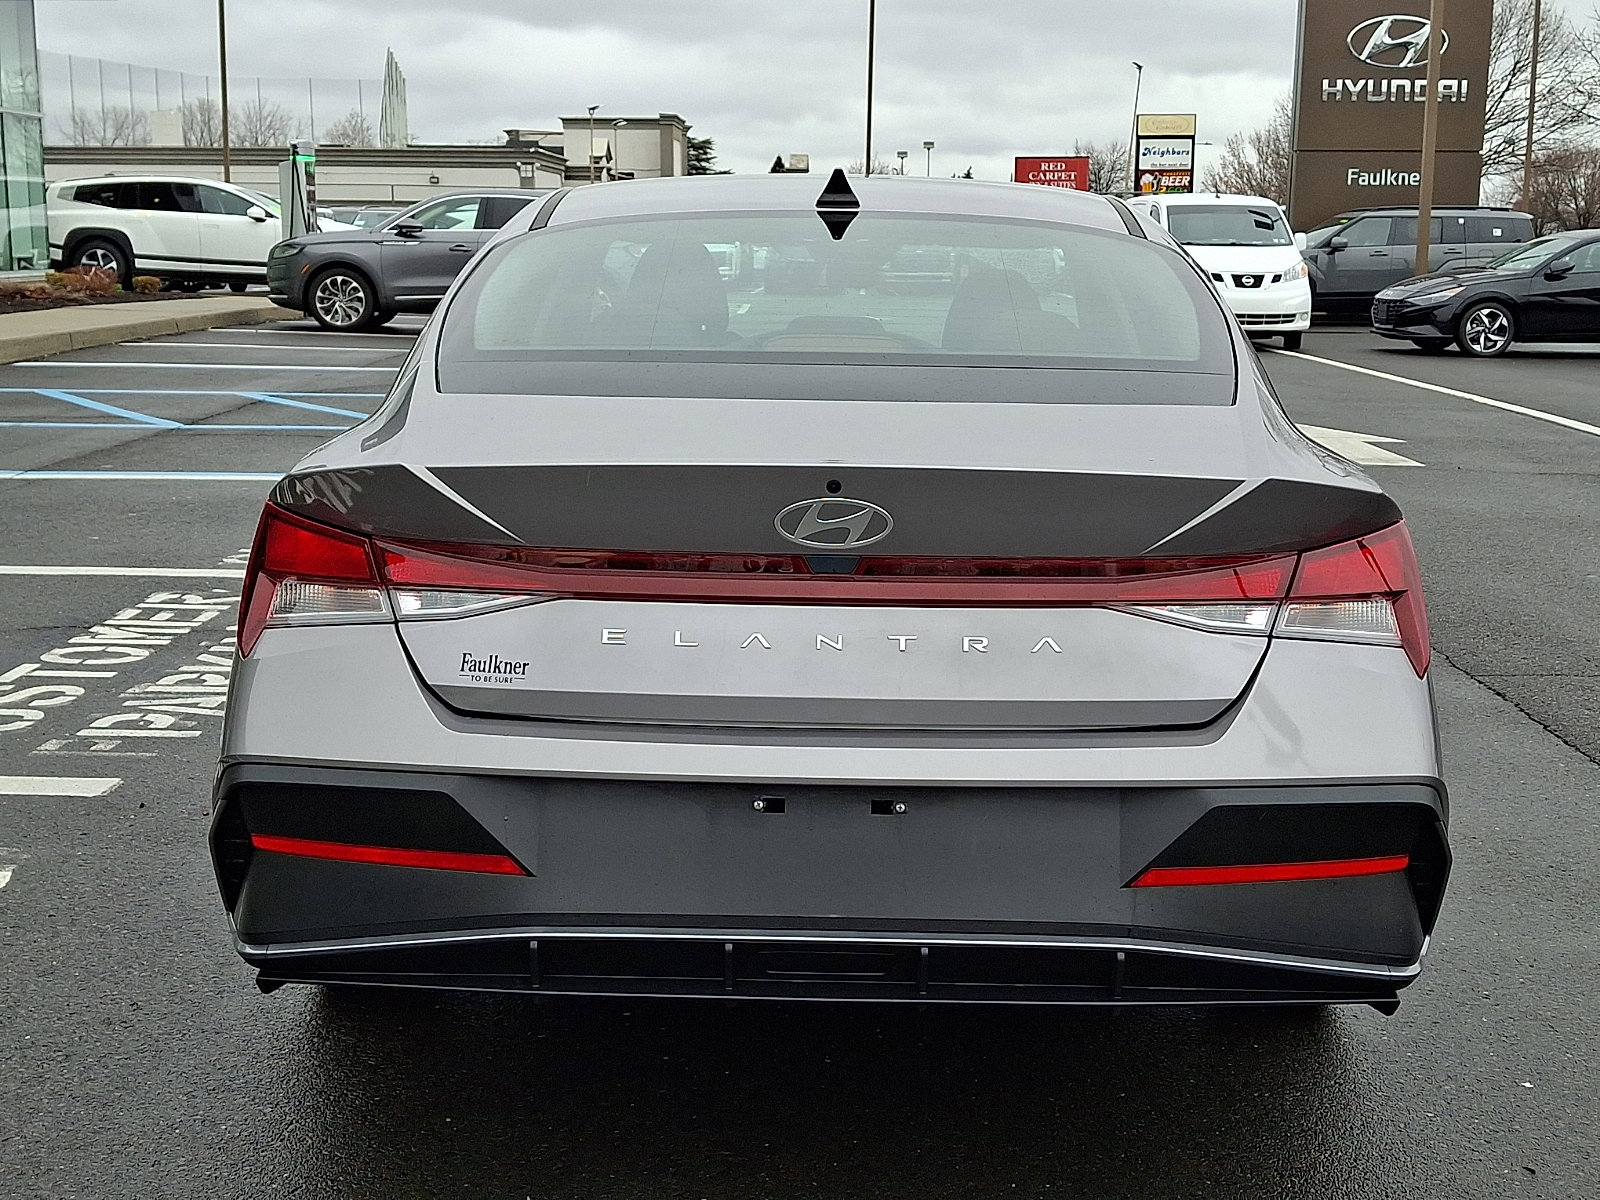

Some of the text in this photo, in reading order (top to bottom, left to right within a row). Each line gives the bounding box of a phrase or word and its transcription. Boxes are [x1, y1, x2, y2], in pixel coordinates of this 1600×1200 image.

[1322, 78, 1469, 102] HYUNDAI
[1141, 146, 1190, 158] Neighbors
[1041, 162, 1066, 171] RED
[1028, 171, 1078, 180] CARPET
[1160, 176, 1190, 187] BEER
[1347, 168, 1421, 186] Faulkne
[601, 627, 1063, 654] ELANTRA
[459, 652, 530, 676] Faulkner
[483, 675, 493, 683] BE
[494, 676, 513, 684] SURE
